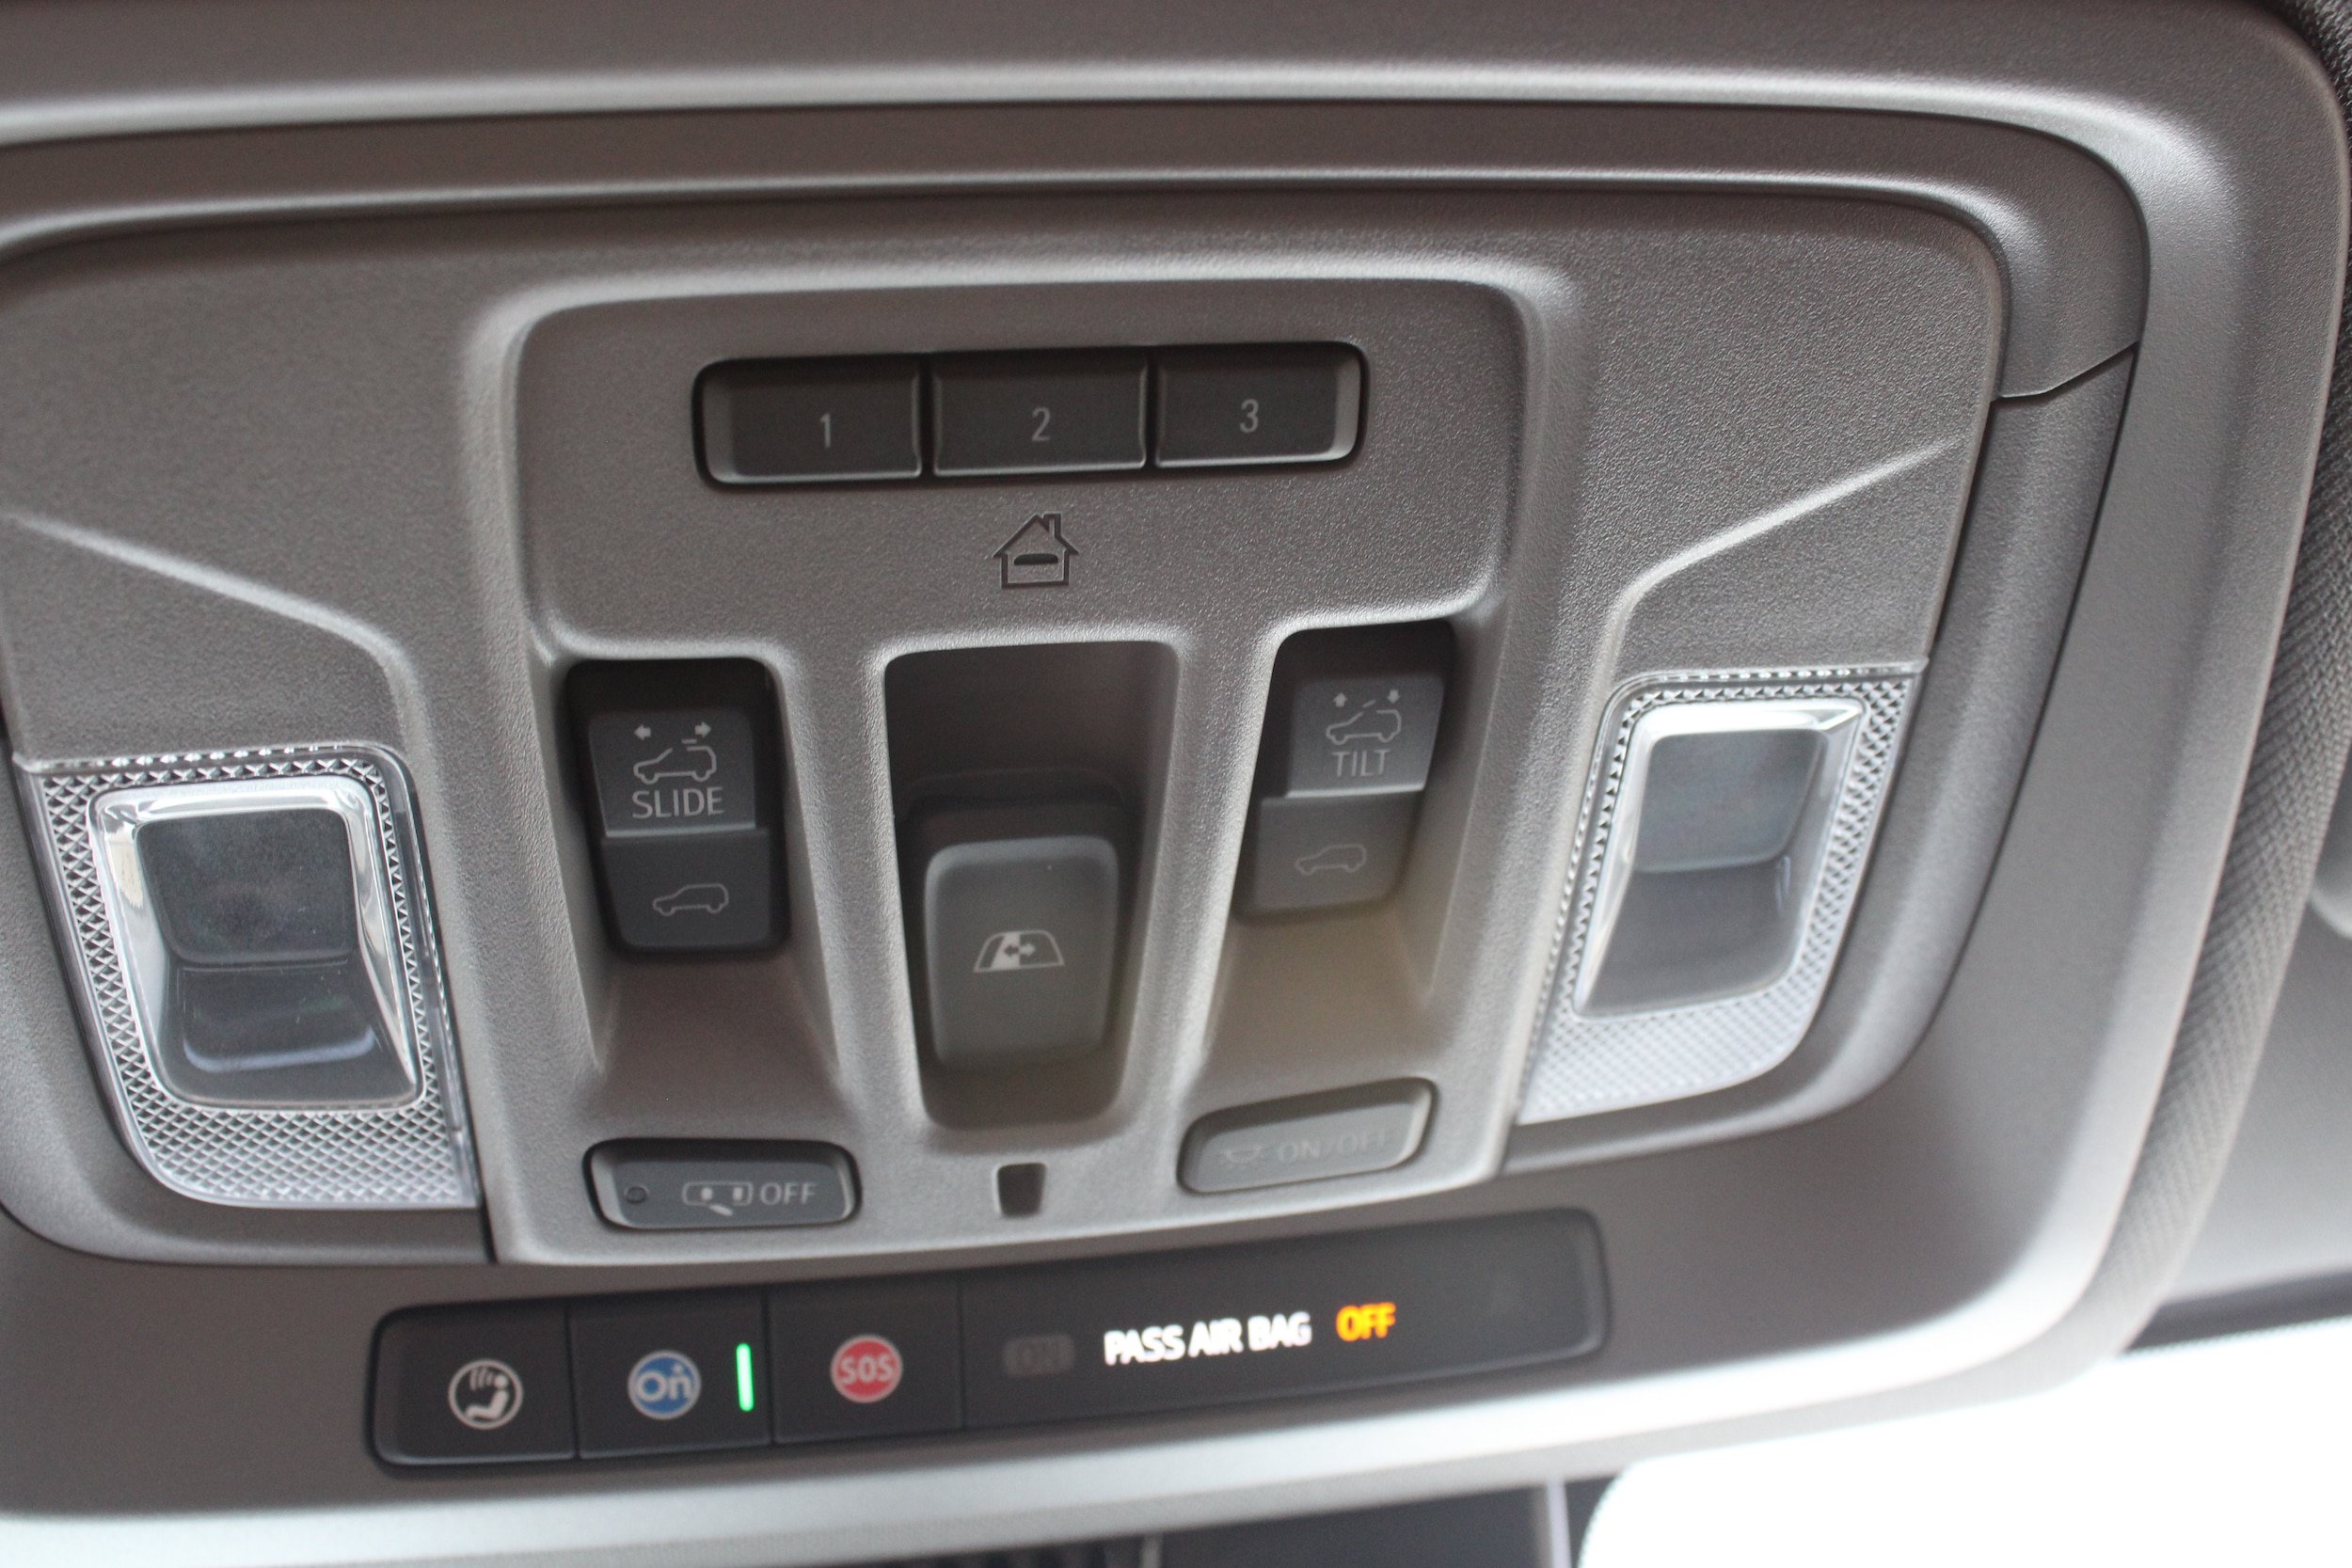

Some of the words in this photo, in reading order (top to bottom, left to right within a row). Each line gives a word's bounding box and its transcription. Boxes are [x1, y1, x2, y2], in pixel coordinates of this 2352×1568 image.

[820, 412, 832, 449] 1
[1032, 407, 1051, 442] 2
[1239, 399, 1260, 434] 3
[1331, 749, 1391, 777] TILT
[631, 786, 724, 819] SLIDE
[759, 1181, 817, 1206] OFF
[1104, 1324, 1185, 1365] PASS
[1189, 1318, 1244, 1357] AIR
[1248, 1311, 1312, 1352] BAG
[1336, 1302, 1396, 1341] OFF
[842, 1354, 895, 1385] SOS
